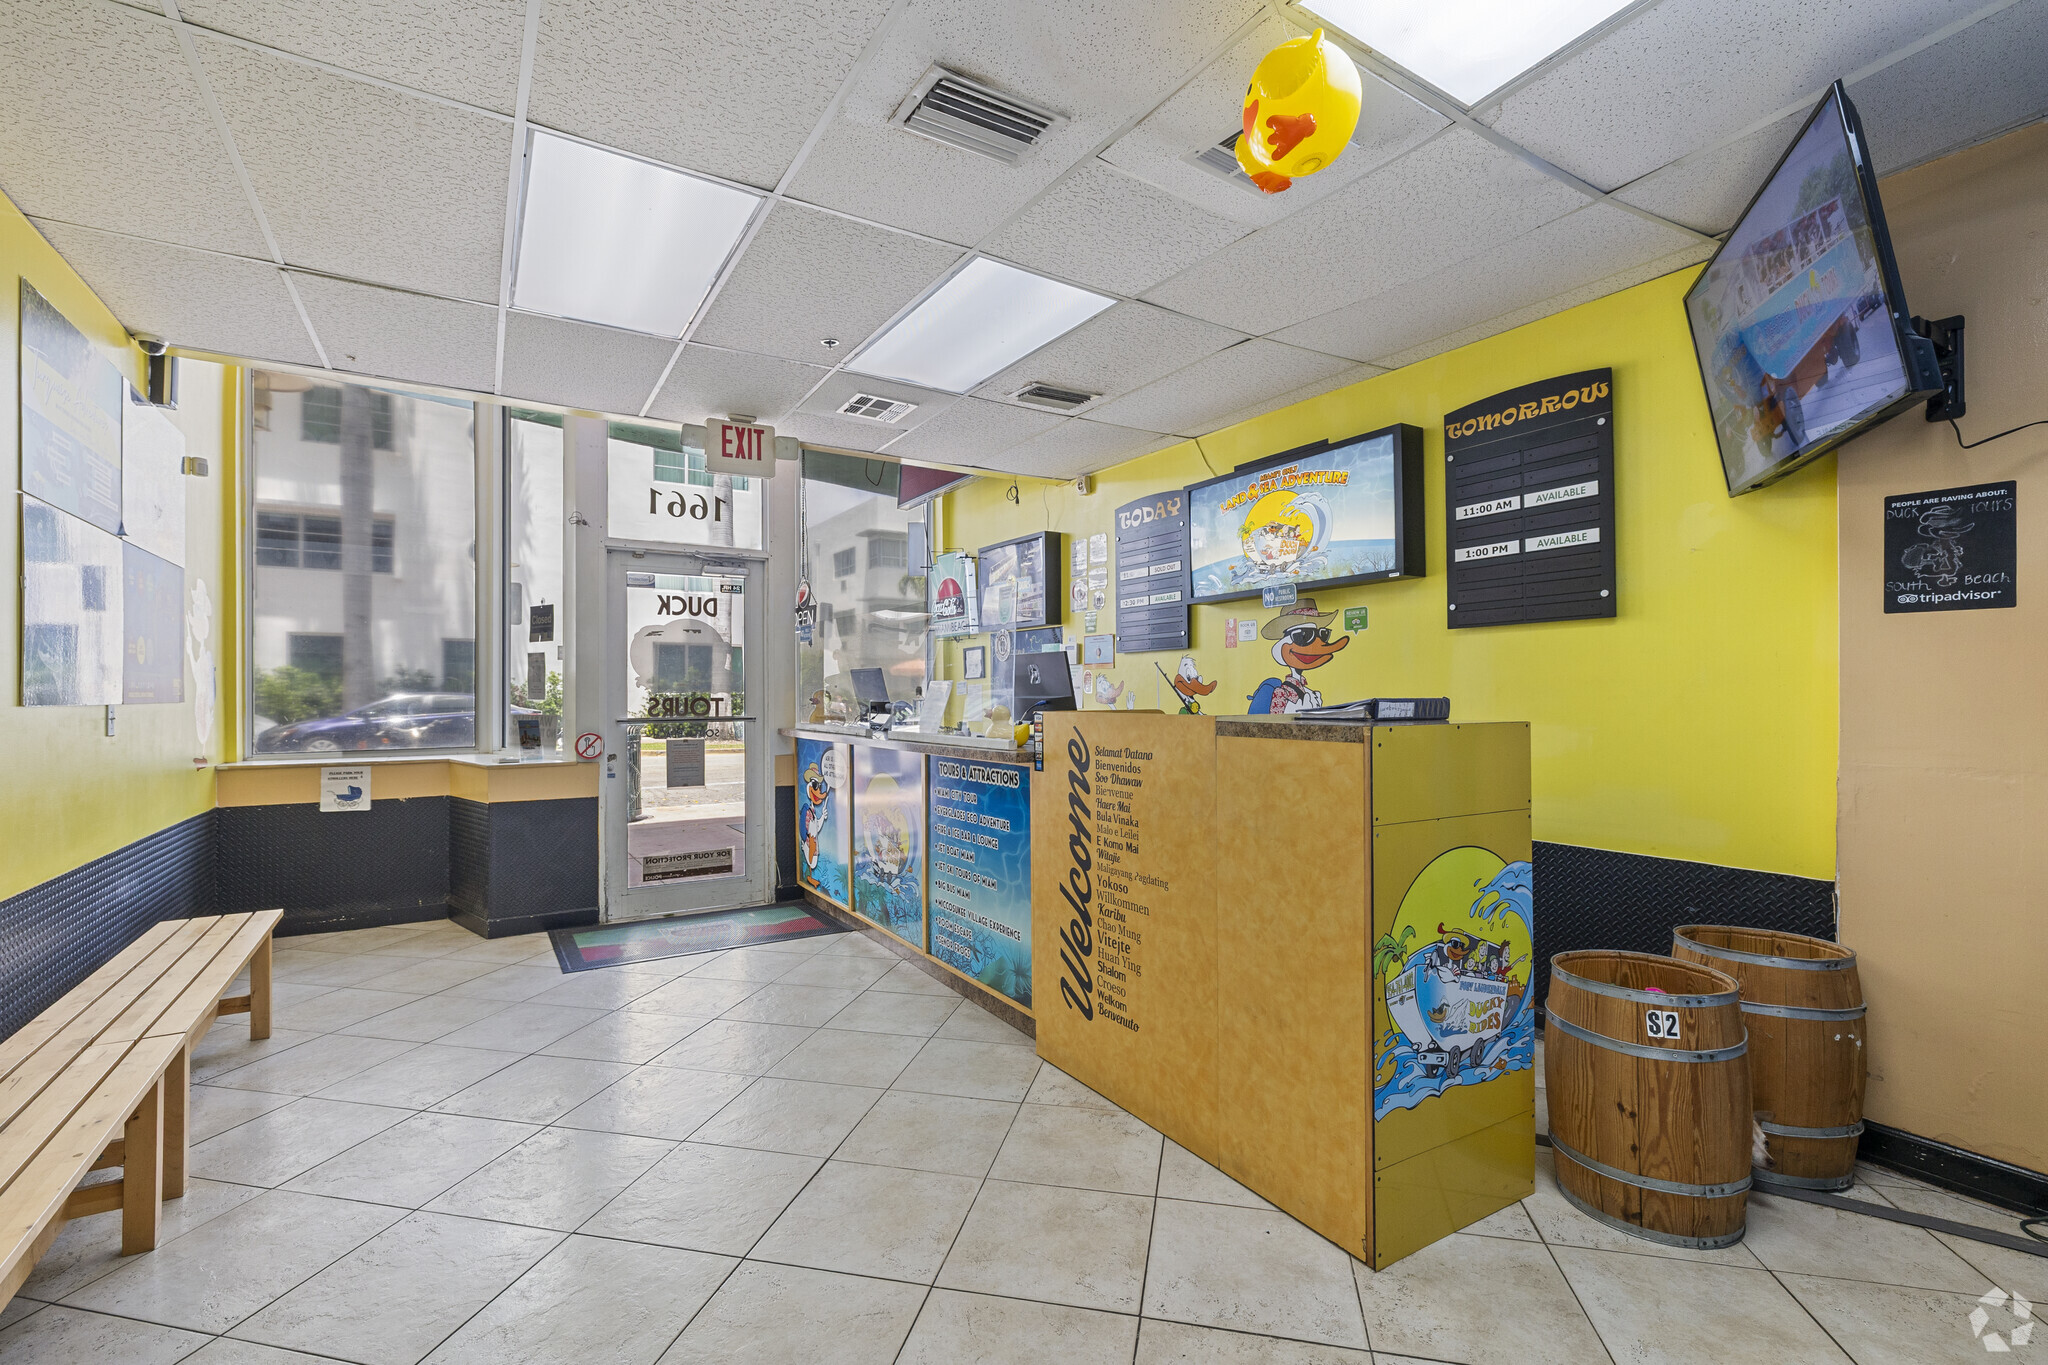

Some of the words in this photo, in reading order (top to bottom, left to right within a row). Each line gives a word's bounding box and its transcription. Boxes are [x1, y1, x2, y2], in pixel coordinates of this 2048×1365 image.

[1446, 381, 1609, 439] TOMORROW
[721, 424, 765, 461] EXIT
[1282, 465, 1298, 475] ONLY
[1220, 491, 1247, 514] LAND
[1247, 483, 1260, 501] &
[1260, 479, 1278, 494] SEA
[1280, 471, 1349, 489] ADVENTURE
[1536, 486, 1586, 504] AVAILABLE
[1891, 499, 1922, 509] PEOPLE
[1923, 497, 1940, 505] ARE
[1941, 492, 1974, 503] RAVING
[1975, 489, 2008, 499] ABOUT:
[1119, 497, 1181, 530] TODAY
[1463, 502, 1493, 517] 11:00
[1495, 500, 1512, 511] AM
[1887, 507, 1919, 520] DUCK
[1537, 532, 1587, 548] AVAILABLE
[1465, 547, 1489, 558] 1:00
[1492, 544, 1508, 554] PM
[1154, 594, 1177, 602] AVAILABLE
[1264, 592, 1275, 602] NO
[1920, 591, 2001, 604] tripadvisor
[531, 615, 552, 625] Closed
[1095, 745, 1122, 759] Selamat
[939, 761, 960, 778] TOURS
[961, 765, 967, 780] &
[968, 766, 1020, 788] ATTRACTIONS
[1095, 760, 1141, 774] Bienvenidos
[1095, 771, 1109, 783] Soo
[937, 786, 950, 799] MIAMI
[951, 789, 962, 802] CITY
[963, 791, 978, 805] TOUR
[1095, 785, 1134, 800] Bienvenue
[1095, 797, 1116, 810] Haere
[1117, 801, 1131, 814] Mai
[937, 804, 966, 822] EVERGLADES
[966, 811, 978, 825] ECO
[979, 814, 1010, 833] ADVENTURE
[1096, 811, 1112, 823] Bula
[1113, 813, 1139, 828] Vinaka
[937, 823, 946, 835] FIRE
[947, 826, 952, 837] &
[952, 827, 960, 840] ICE
[961, 829, 971, 842] BAR
[972, 833, 977, 845] &
[977, 834, 999, 850] LOUNGE
[1096, 823, 1114, 837] Malo
[1114, 829, 1119, 837] e
[1120, 827, 1139, 841] Leilei
[937, 842, 946, 853] JET
[946, 845, 960, 858] BOAT
[961, 849, 975, 863] MIAMI
[1096, 836, 1102, 846] E
[1103, 837, 1124, 851] Komo
[1125, 842, 1139, 855] Mai
[937, 861, 946, 873] JET
[955, 867, 972, 881] TOURS
[972, 872, 981, 884] OF
[981, 874, 998, 891] MIAMI
[1059, 725, 1093, 1021] Welcome
[1096, 861, 1133, 881] Maligayang
[937, 879, 946, 891] BIG
[946, 882, 956, 895] BUS
[956, 886, 972, 901] MIAMI
[1096, 874, 1129, 894] Yokoso
[1096, 888, 1150, 917] Willkommen
[937, 898, 967, 918] MICCOSUKEE
[967, 909, 988, 928] VILLAGE
[989, 918, 1022, 942] EXPERIENCE
[1097, 903, 1126, 924] Karibu
[953, 922, 973, 941] ESCAPE
[1097, 917, 1117, 934] Chao
[1118, 924, 1142, 946] Mung
[953, 941, 972, 959] FROGS
[1097, 929, 1131, 956] Vitejte
[1098, 946, 1120, 965] Huan
[1121, 955, 1142, 978] Ying
[1098, 960, 1127, 983] Shalom
[1096, 974, 1127, 998] Croeso
[1096, 988, 1128, 1013] Welkom
[1468, 996, 1505, 1019] DUCKY
[1097, 1001, 1140, 1033] Benvenuto
[1468, 1011, 1501, 1034] RIDES
[1648, 1011, 1678, 1037] S2
